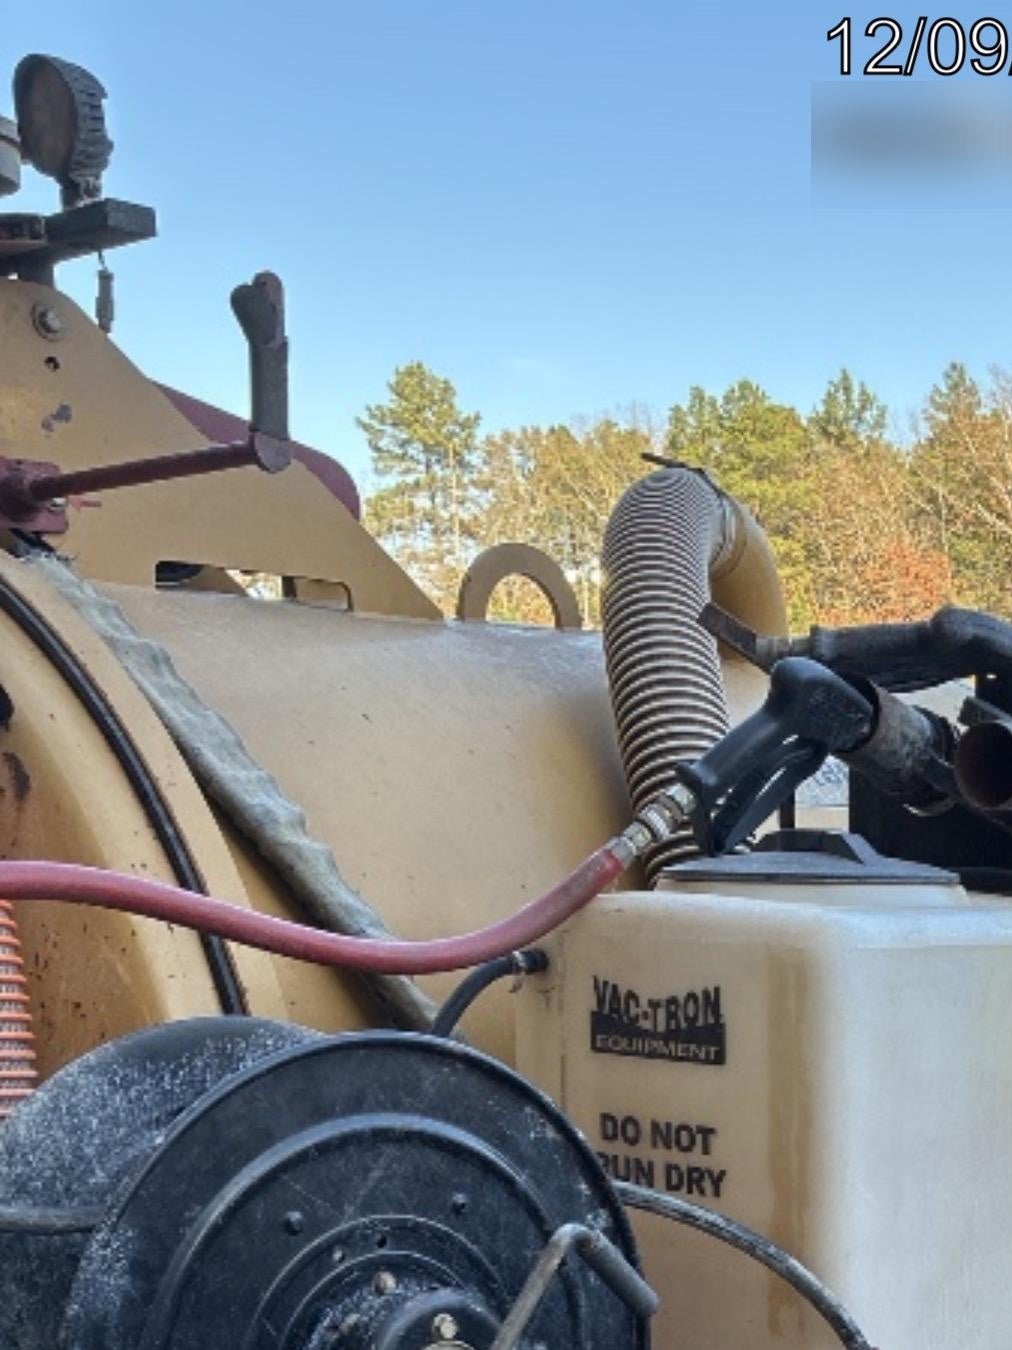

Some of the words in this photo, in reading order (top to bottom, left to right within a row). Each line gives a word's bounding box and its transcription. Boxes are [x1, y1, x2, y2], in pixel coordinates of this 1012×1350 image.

[594, 1033, 719, 1060] EQUIPMENT
[600, 1112, 642, 1147] DO
[651, 1119, 717, 1156] NOT
[665, 1163, 727, 1198] DRY
